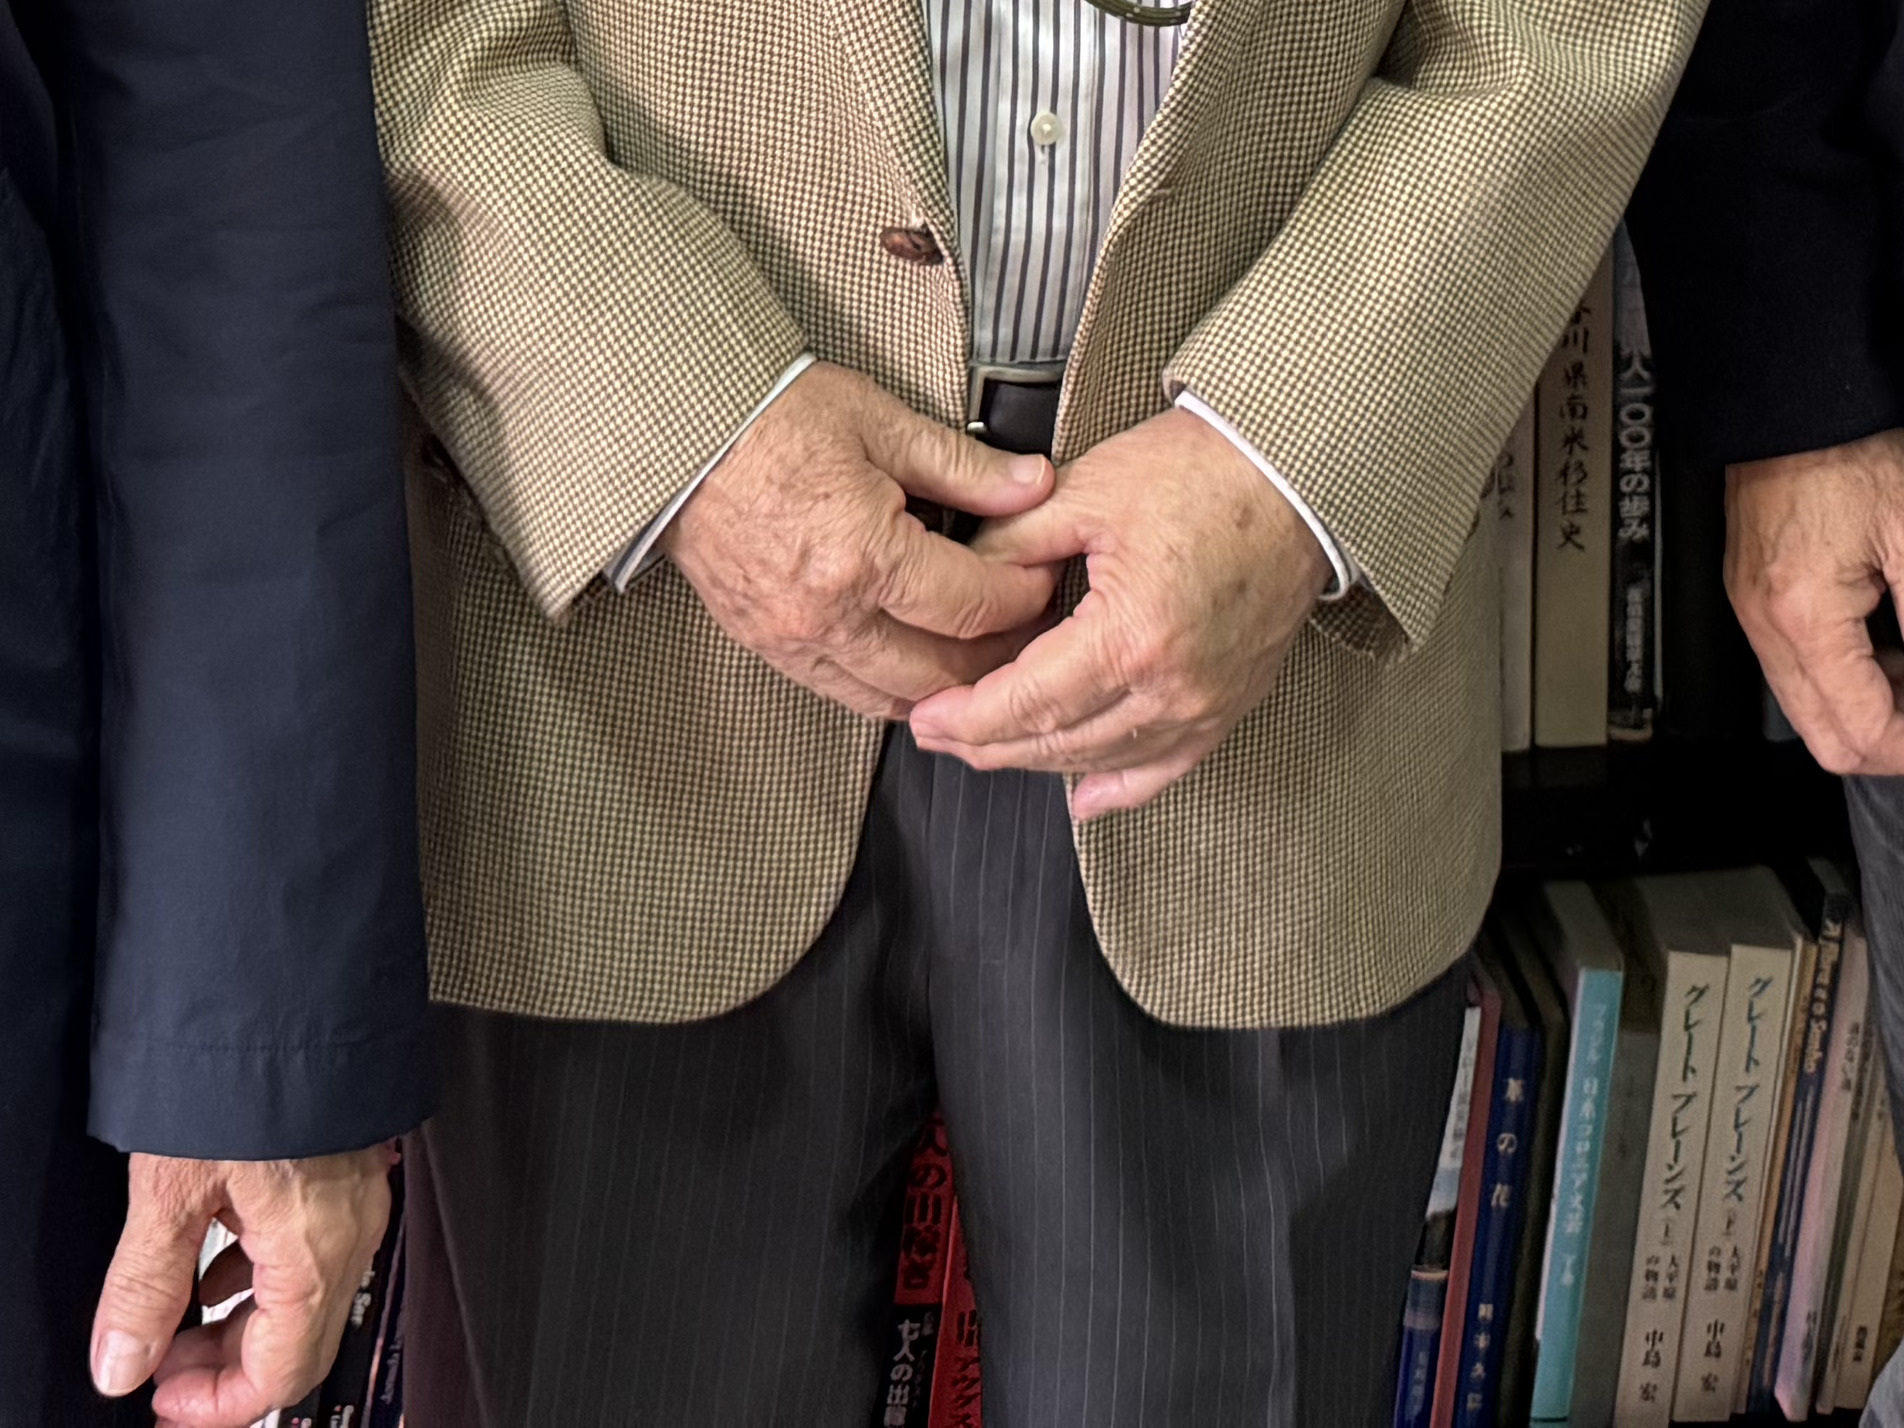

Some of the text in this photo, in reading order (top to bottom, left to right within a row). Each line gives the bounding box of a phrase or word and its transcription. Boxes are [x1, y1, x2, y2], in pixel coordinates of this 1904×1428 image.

[1680, 983, 1712, 1083] グレート
[1745, 976, 1776, 1073] グレート
